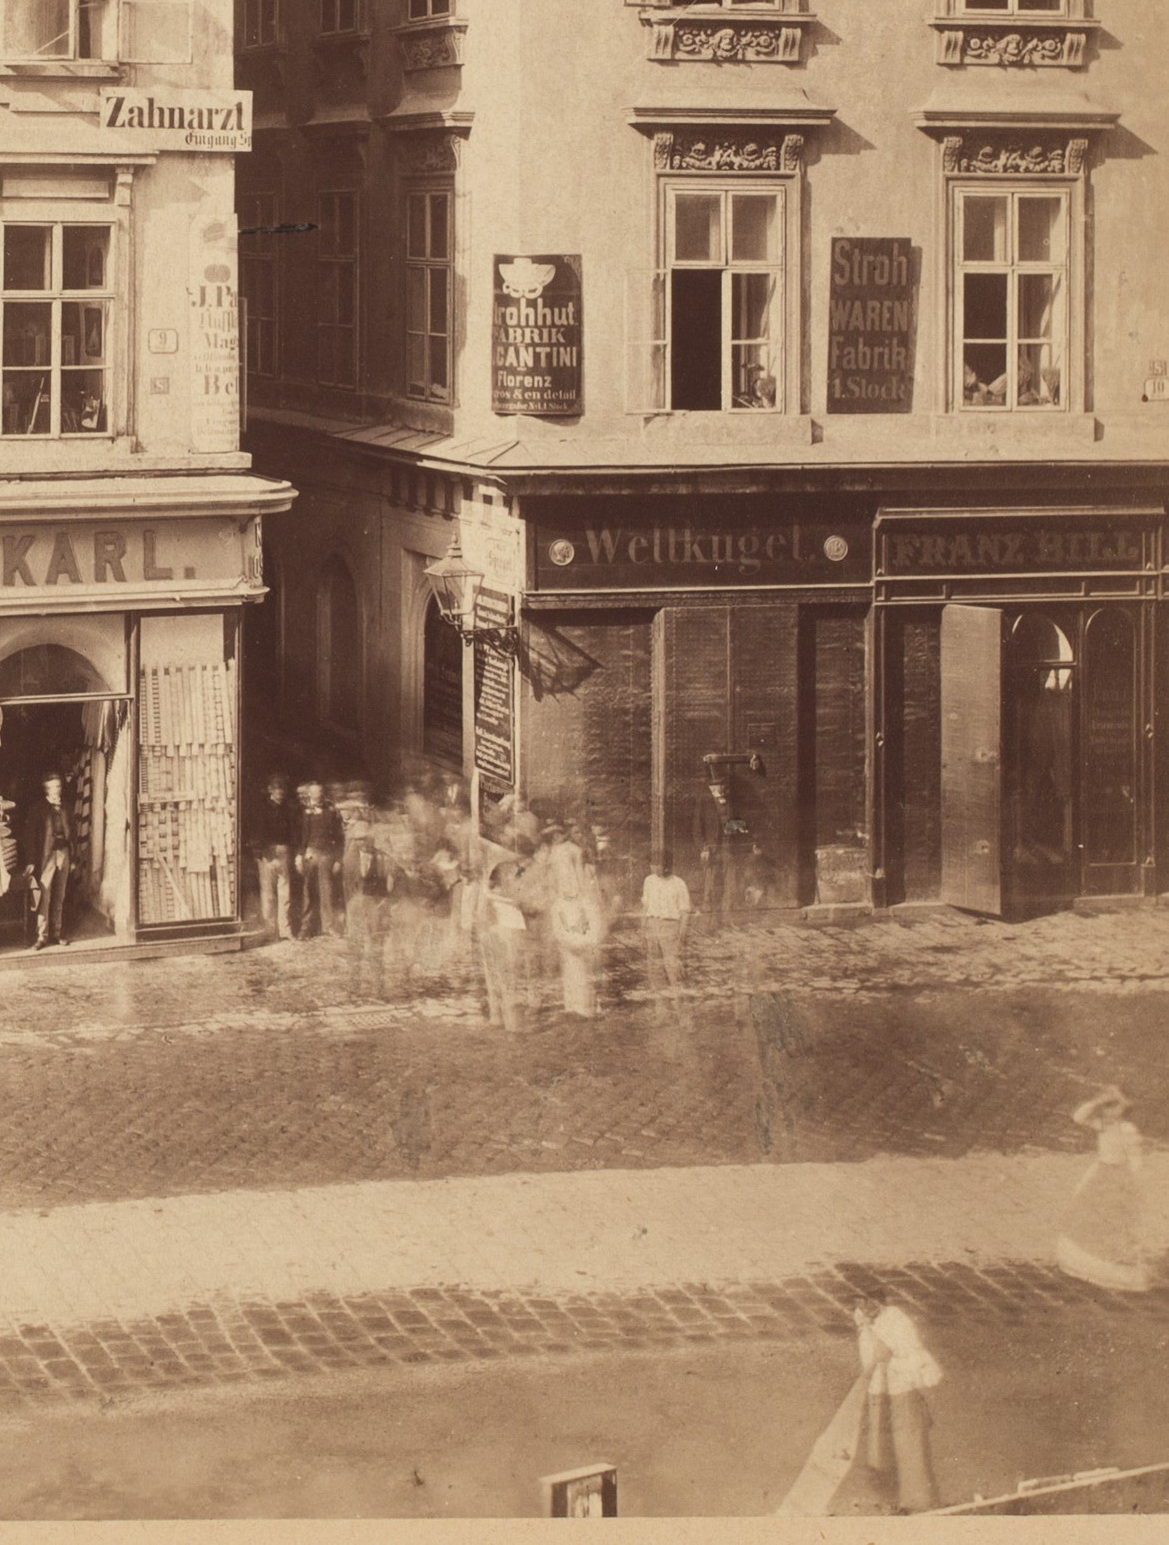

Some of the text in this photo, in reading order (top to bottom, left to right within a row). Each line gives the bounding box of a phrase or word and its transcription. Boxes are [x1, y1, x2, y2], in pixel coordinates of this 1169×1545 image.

[106, 96, 245, 131] Zahnarzt
[834, 240, 908, 286] Stroh
[832, 301, 908, 332] WAREN
[832, 337, 907, 370] Fabrik
[498, 371, 552, 388] Florenz
